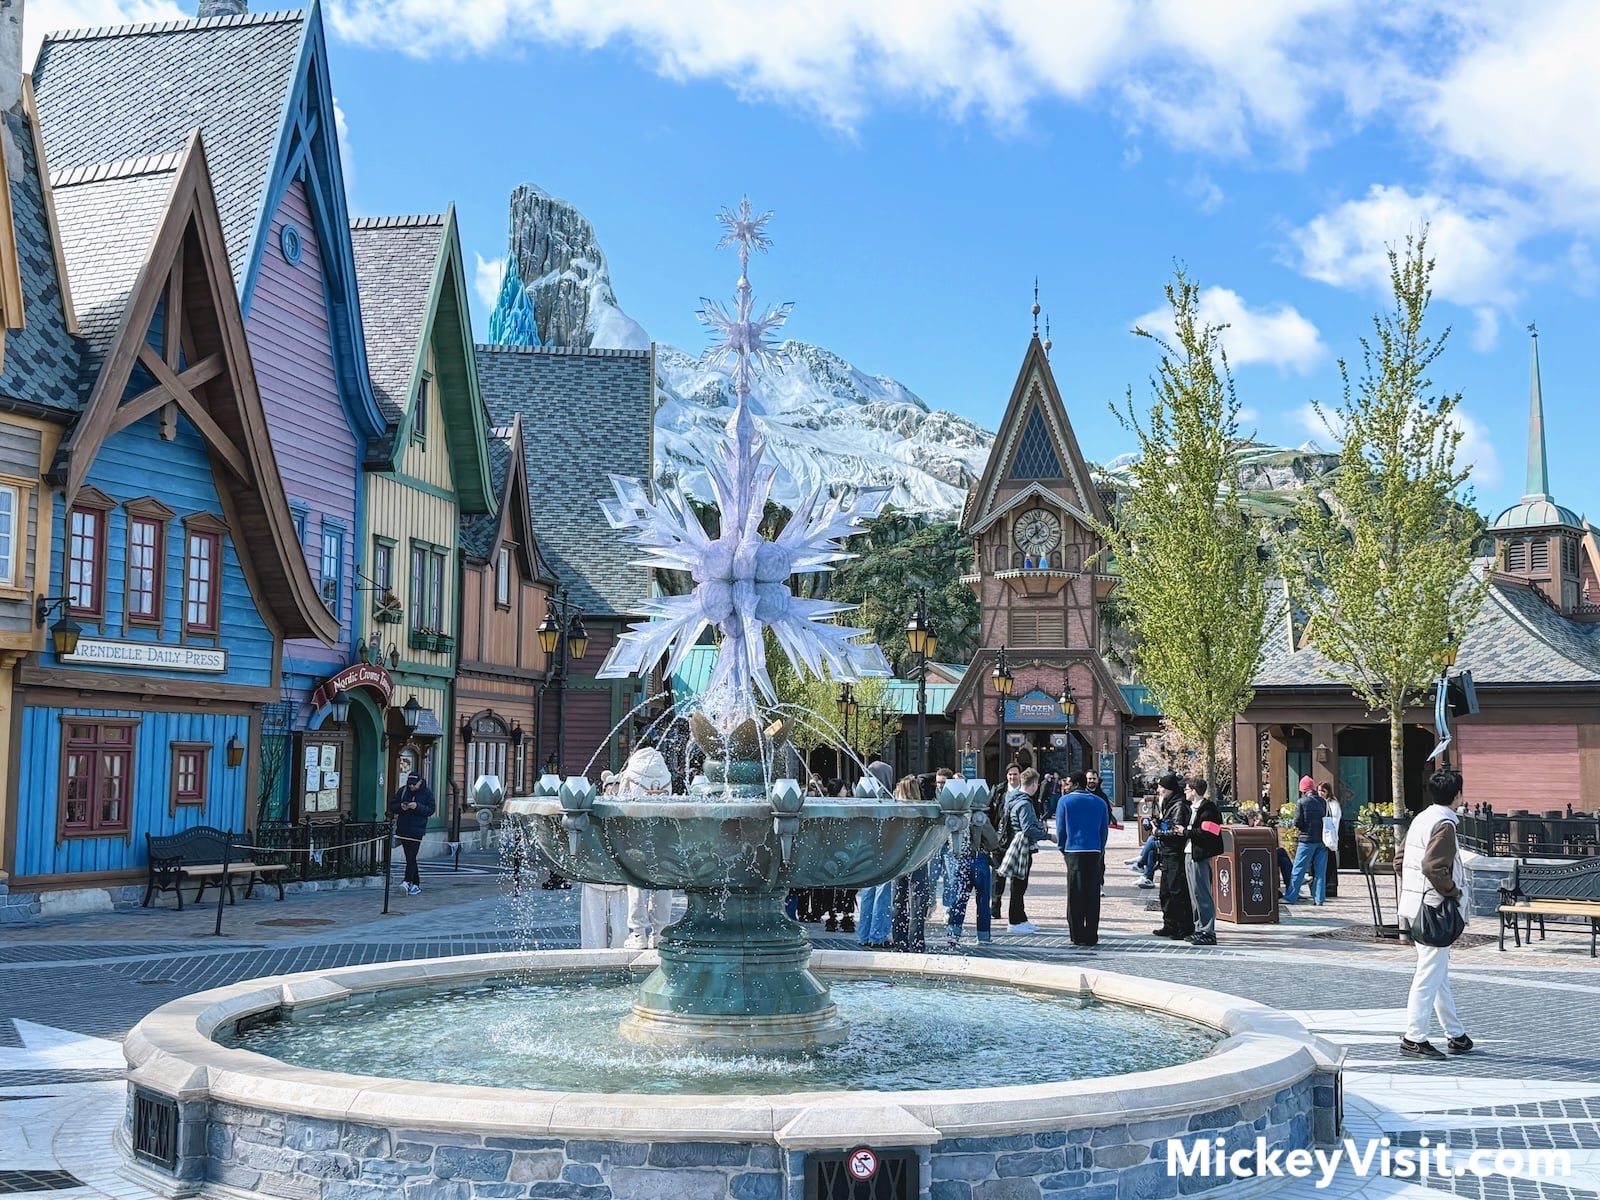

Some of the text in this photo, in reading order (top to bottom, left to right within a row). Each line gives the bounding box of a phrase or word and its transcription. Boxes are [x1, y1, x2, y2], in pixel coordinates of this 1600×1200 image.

[148, 648, 181, 664] DAILY
[185, 652, 220, 666] PRESS
[333, 671, 359, 692] Nordic
[1020, 704, 1054, 712] FROZEN
